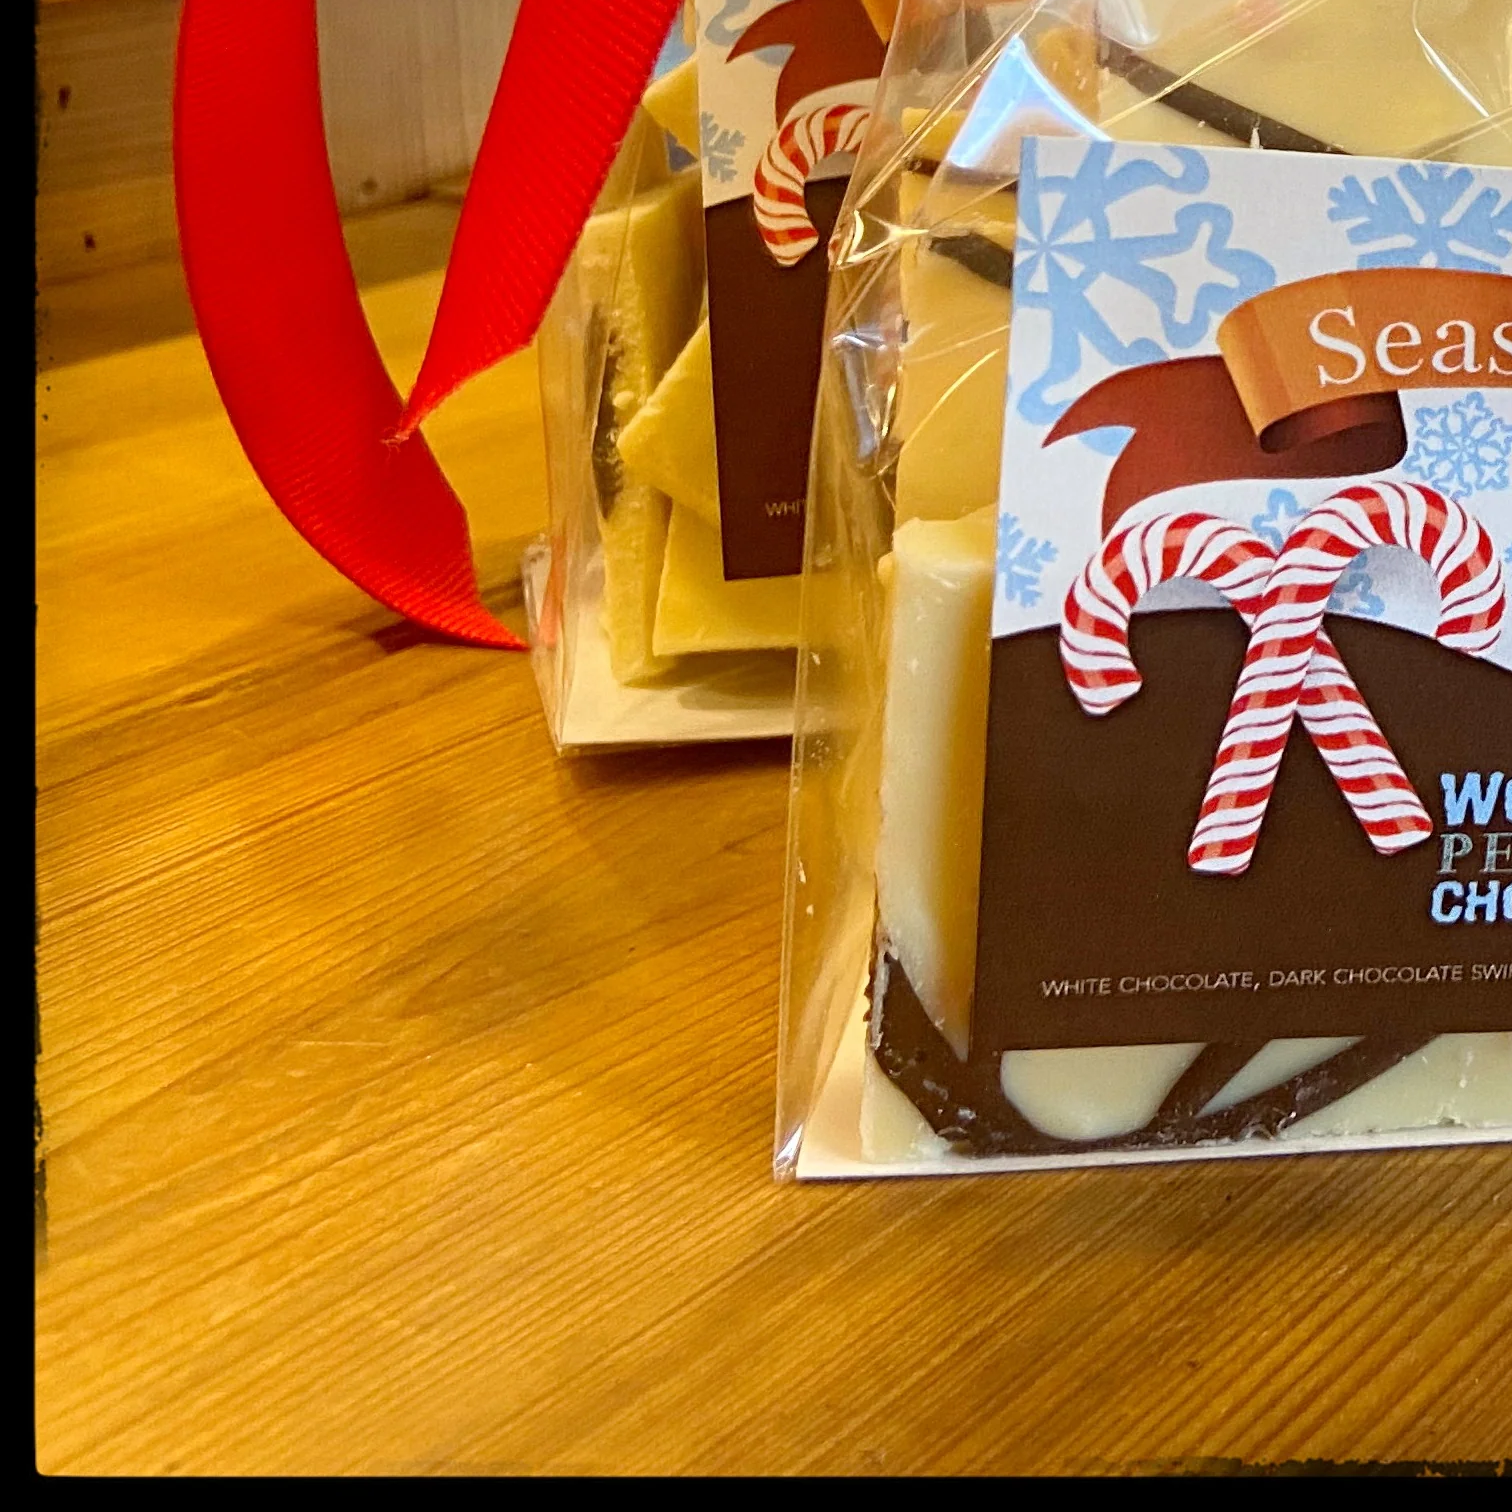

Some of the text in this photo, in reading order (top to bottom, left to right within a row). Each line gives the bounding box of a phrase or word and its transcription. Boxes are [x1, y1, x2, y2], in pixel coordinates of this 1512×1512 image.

[1041, 976, 1112, 998] WHITE
[1119, 970, 1261, 995] CHOCOLATE,
[1268, 968, 1327, 987] DARK
[1333, 964, 1464, 985] CHOCOLATE
